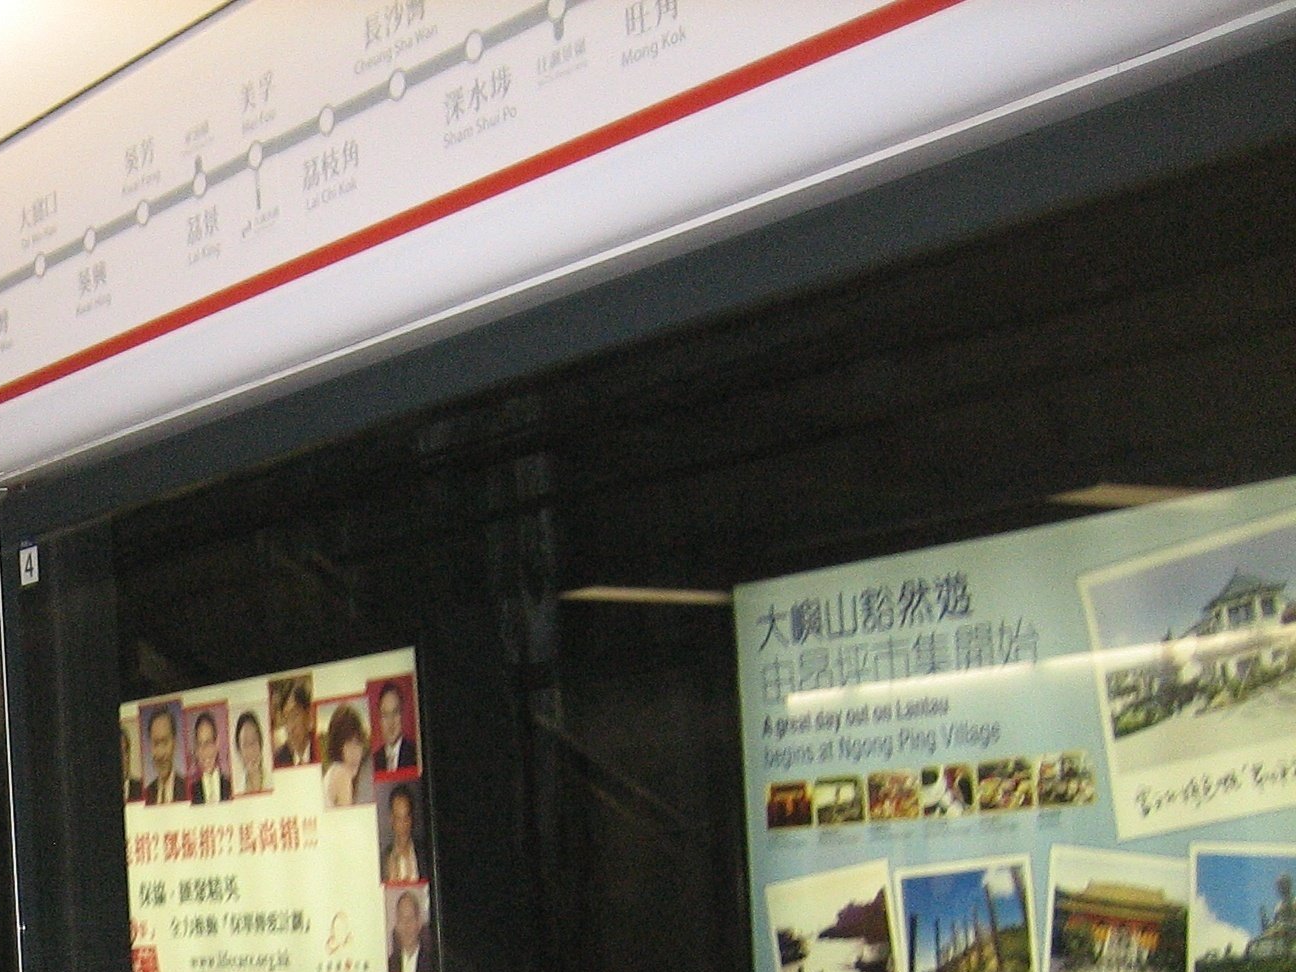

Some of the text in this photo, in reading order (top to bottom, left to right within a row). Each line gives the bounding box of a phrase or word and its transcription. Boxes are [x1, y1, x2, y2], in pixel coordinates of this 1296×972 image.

[415, 23, 438, 44] Wan
[622, 25, 686, 67] Mong Kok
[443, 125, 474, 148] Sham
[503, 105, 517, 122] Po
[25, 553, 34, 577] 4
[762, 696, 950, 740] A great day out on Lantau
[763, 720, 1001, 770] begins at Ngong Ping Village
